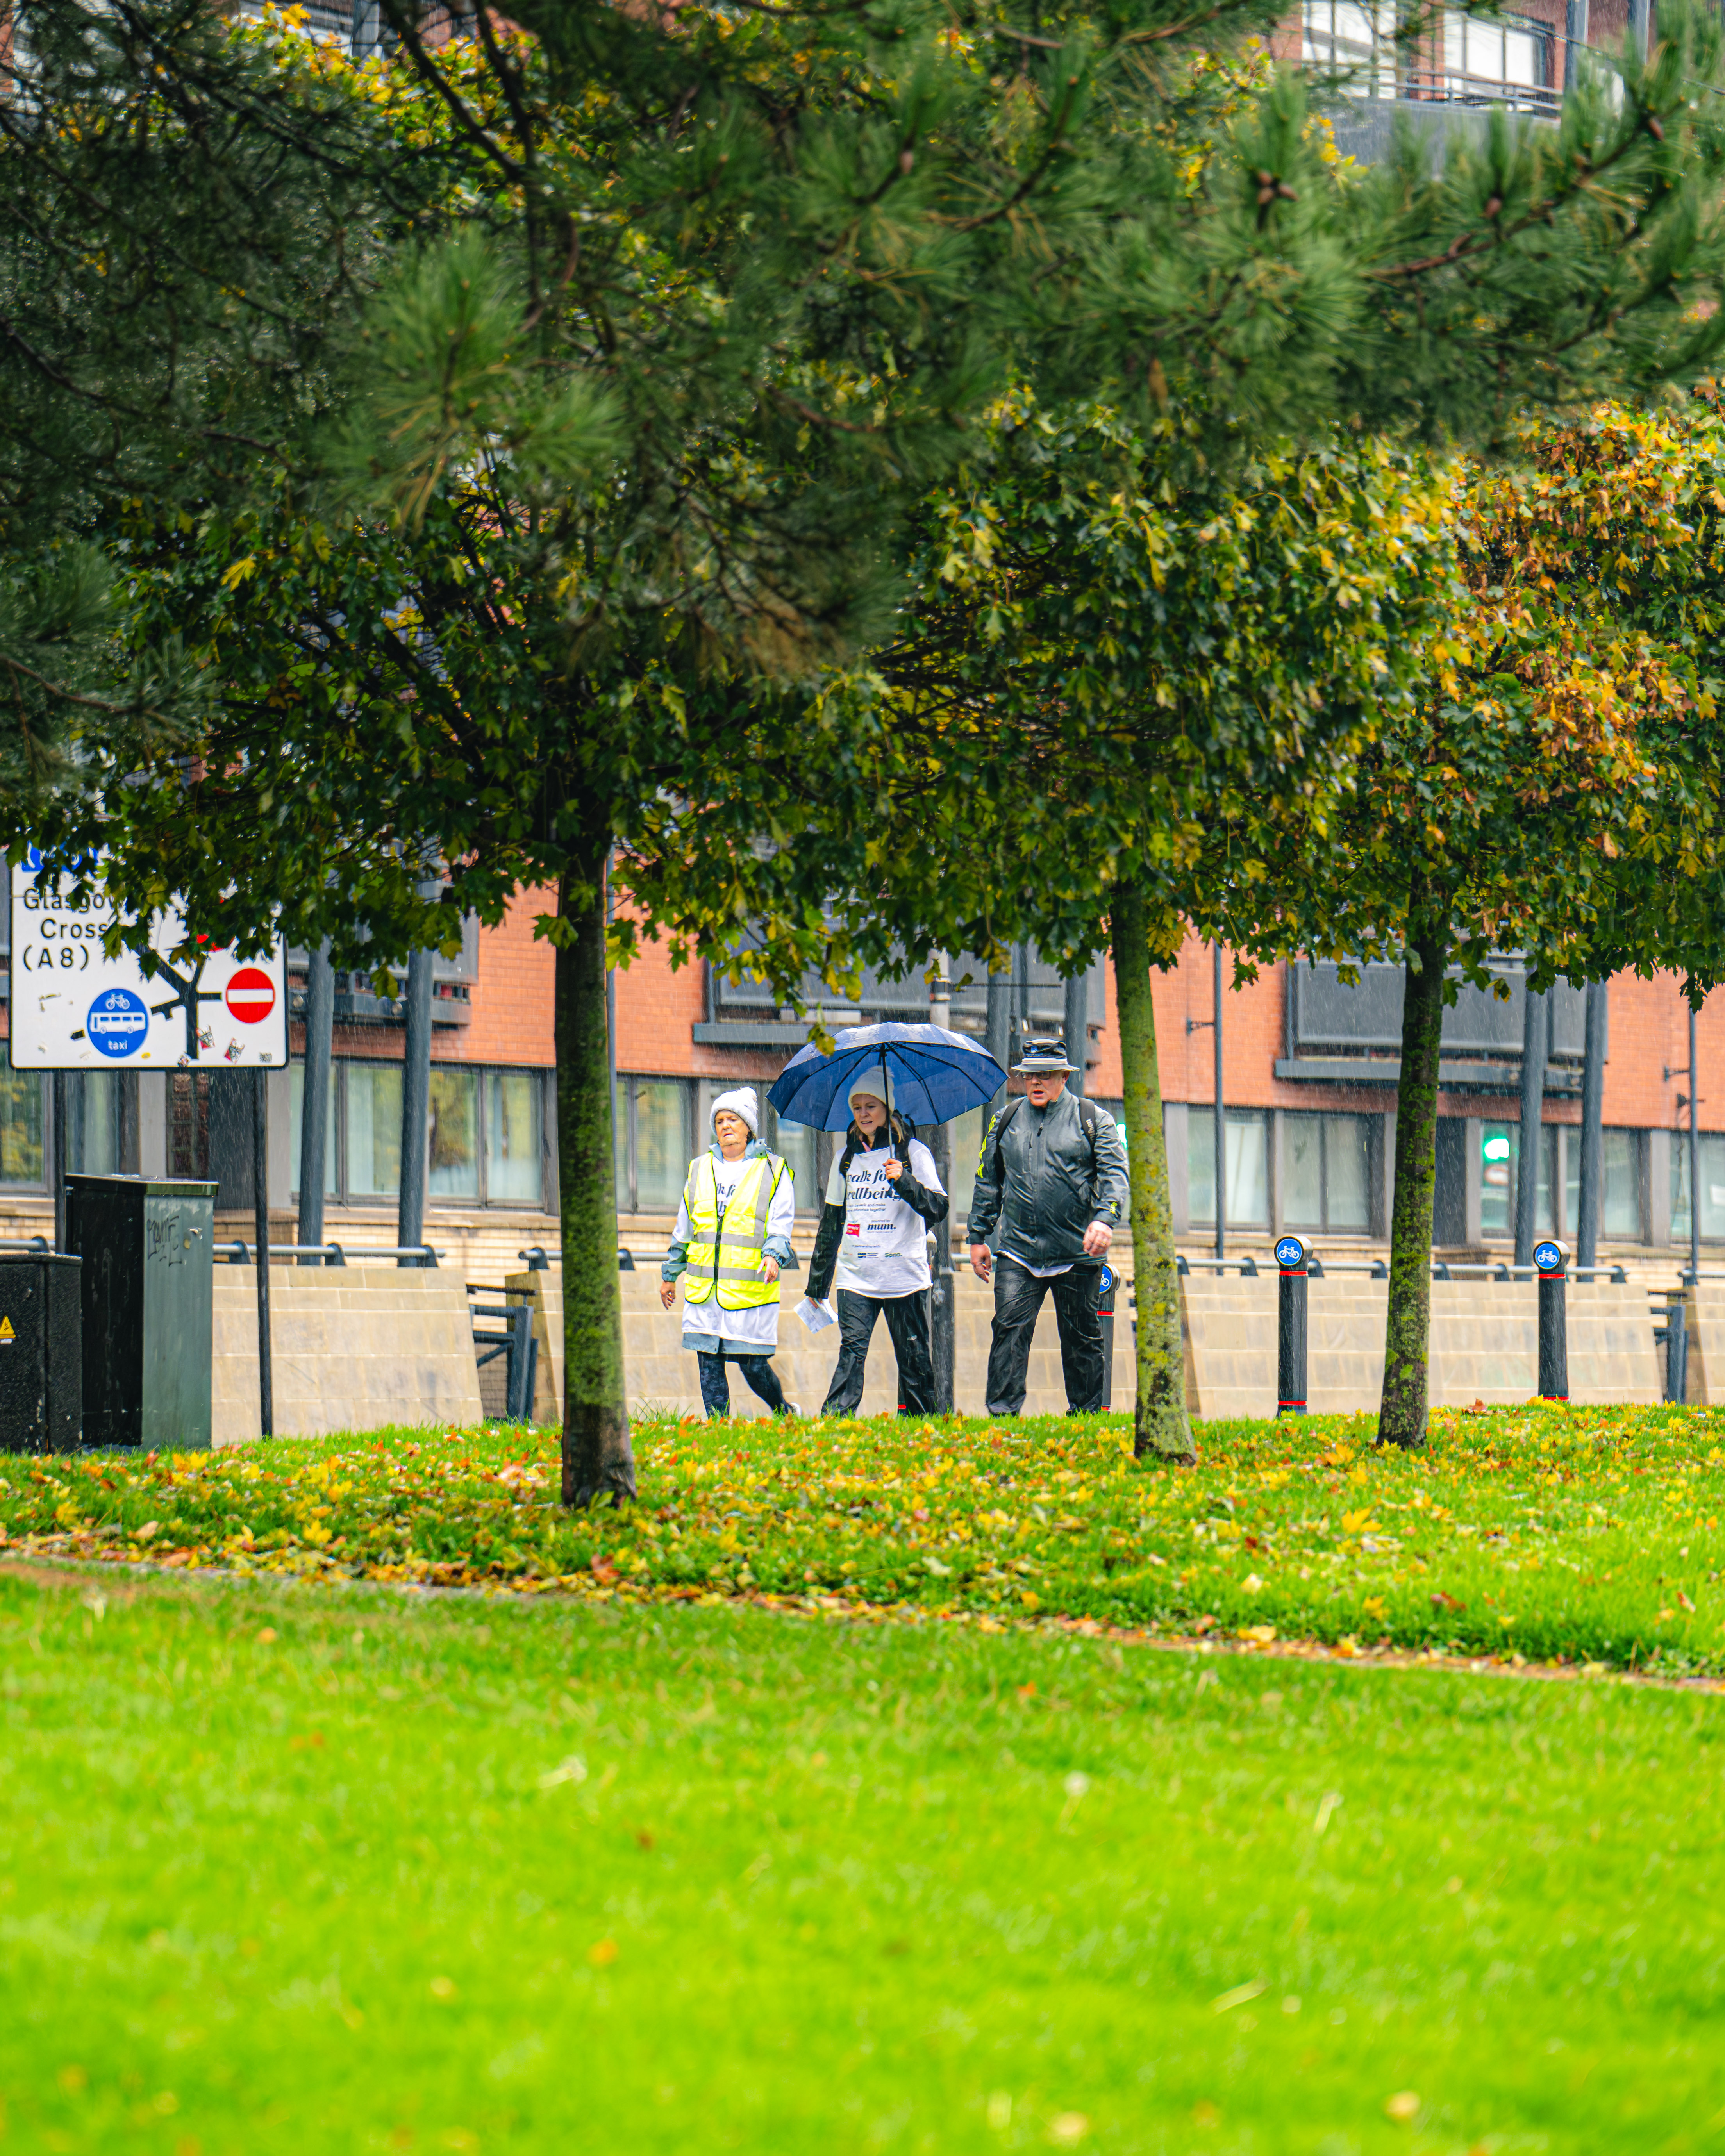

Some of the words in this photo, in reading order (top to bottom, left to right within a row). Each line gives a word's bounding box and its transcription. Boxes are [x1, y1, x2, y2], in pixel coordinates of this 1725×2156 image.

[41, 918, 109, 939] Cross
[23, 944, 90, 972] (A8)
[107, 1039, 128, 1051] taxi
[871, 1169, 886, 1185] fo
